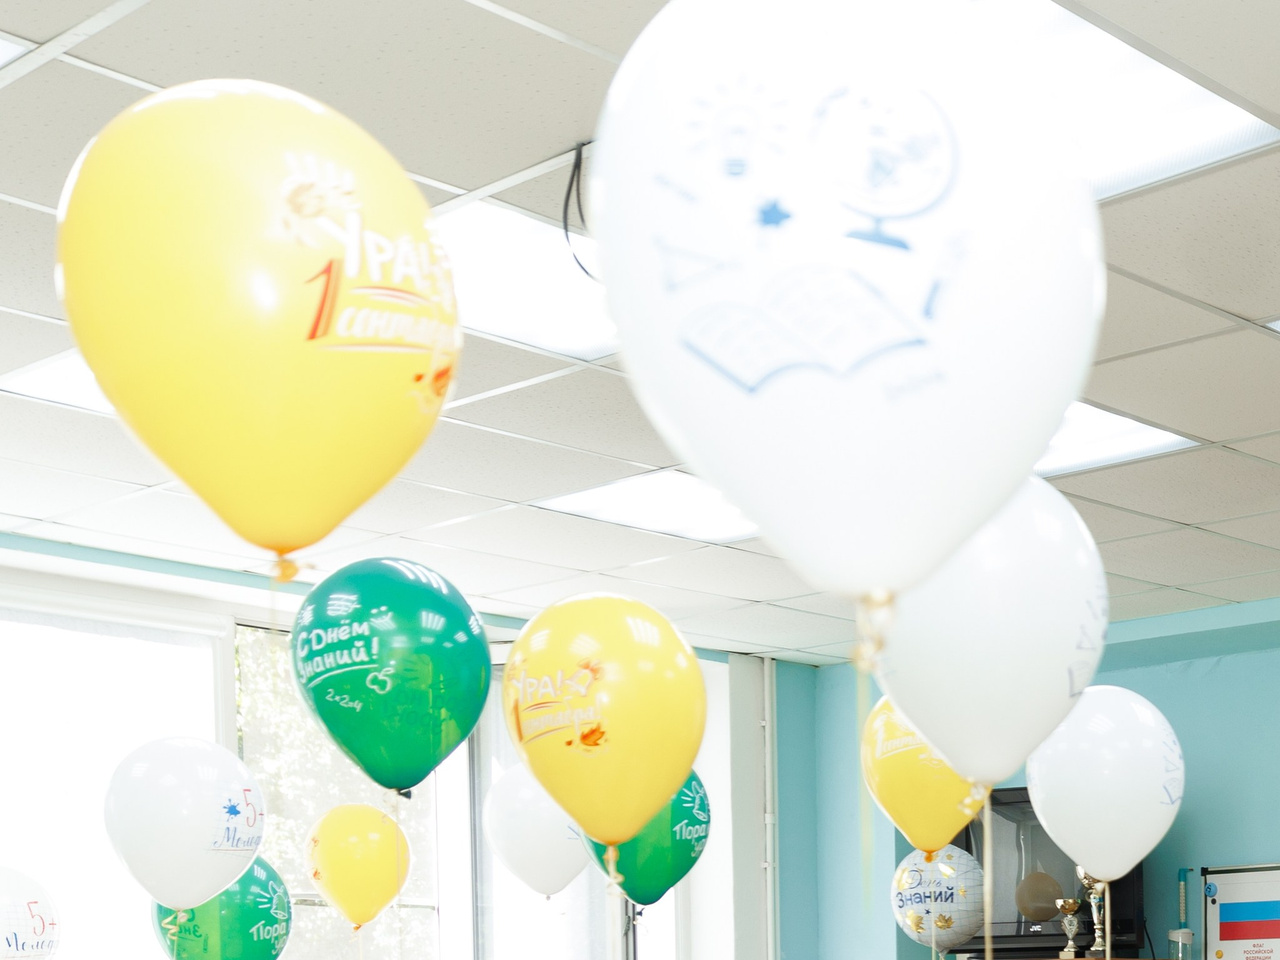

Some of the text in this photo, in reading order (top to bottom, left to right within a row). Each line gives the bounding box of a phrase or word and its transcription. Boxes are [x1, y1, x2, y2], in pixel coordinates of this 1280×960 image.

[309, 619, 371, 651] Днём
[672, 819, 707, 845] Пора
[896, 886, 955, 909] Знаний
[27, 900, 57, 936] 5+
[249, 920, 287, 952] Пора
